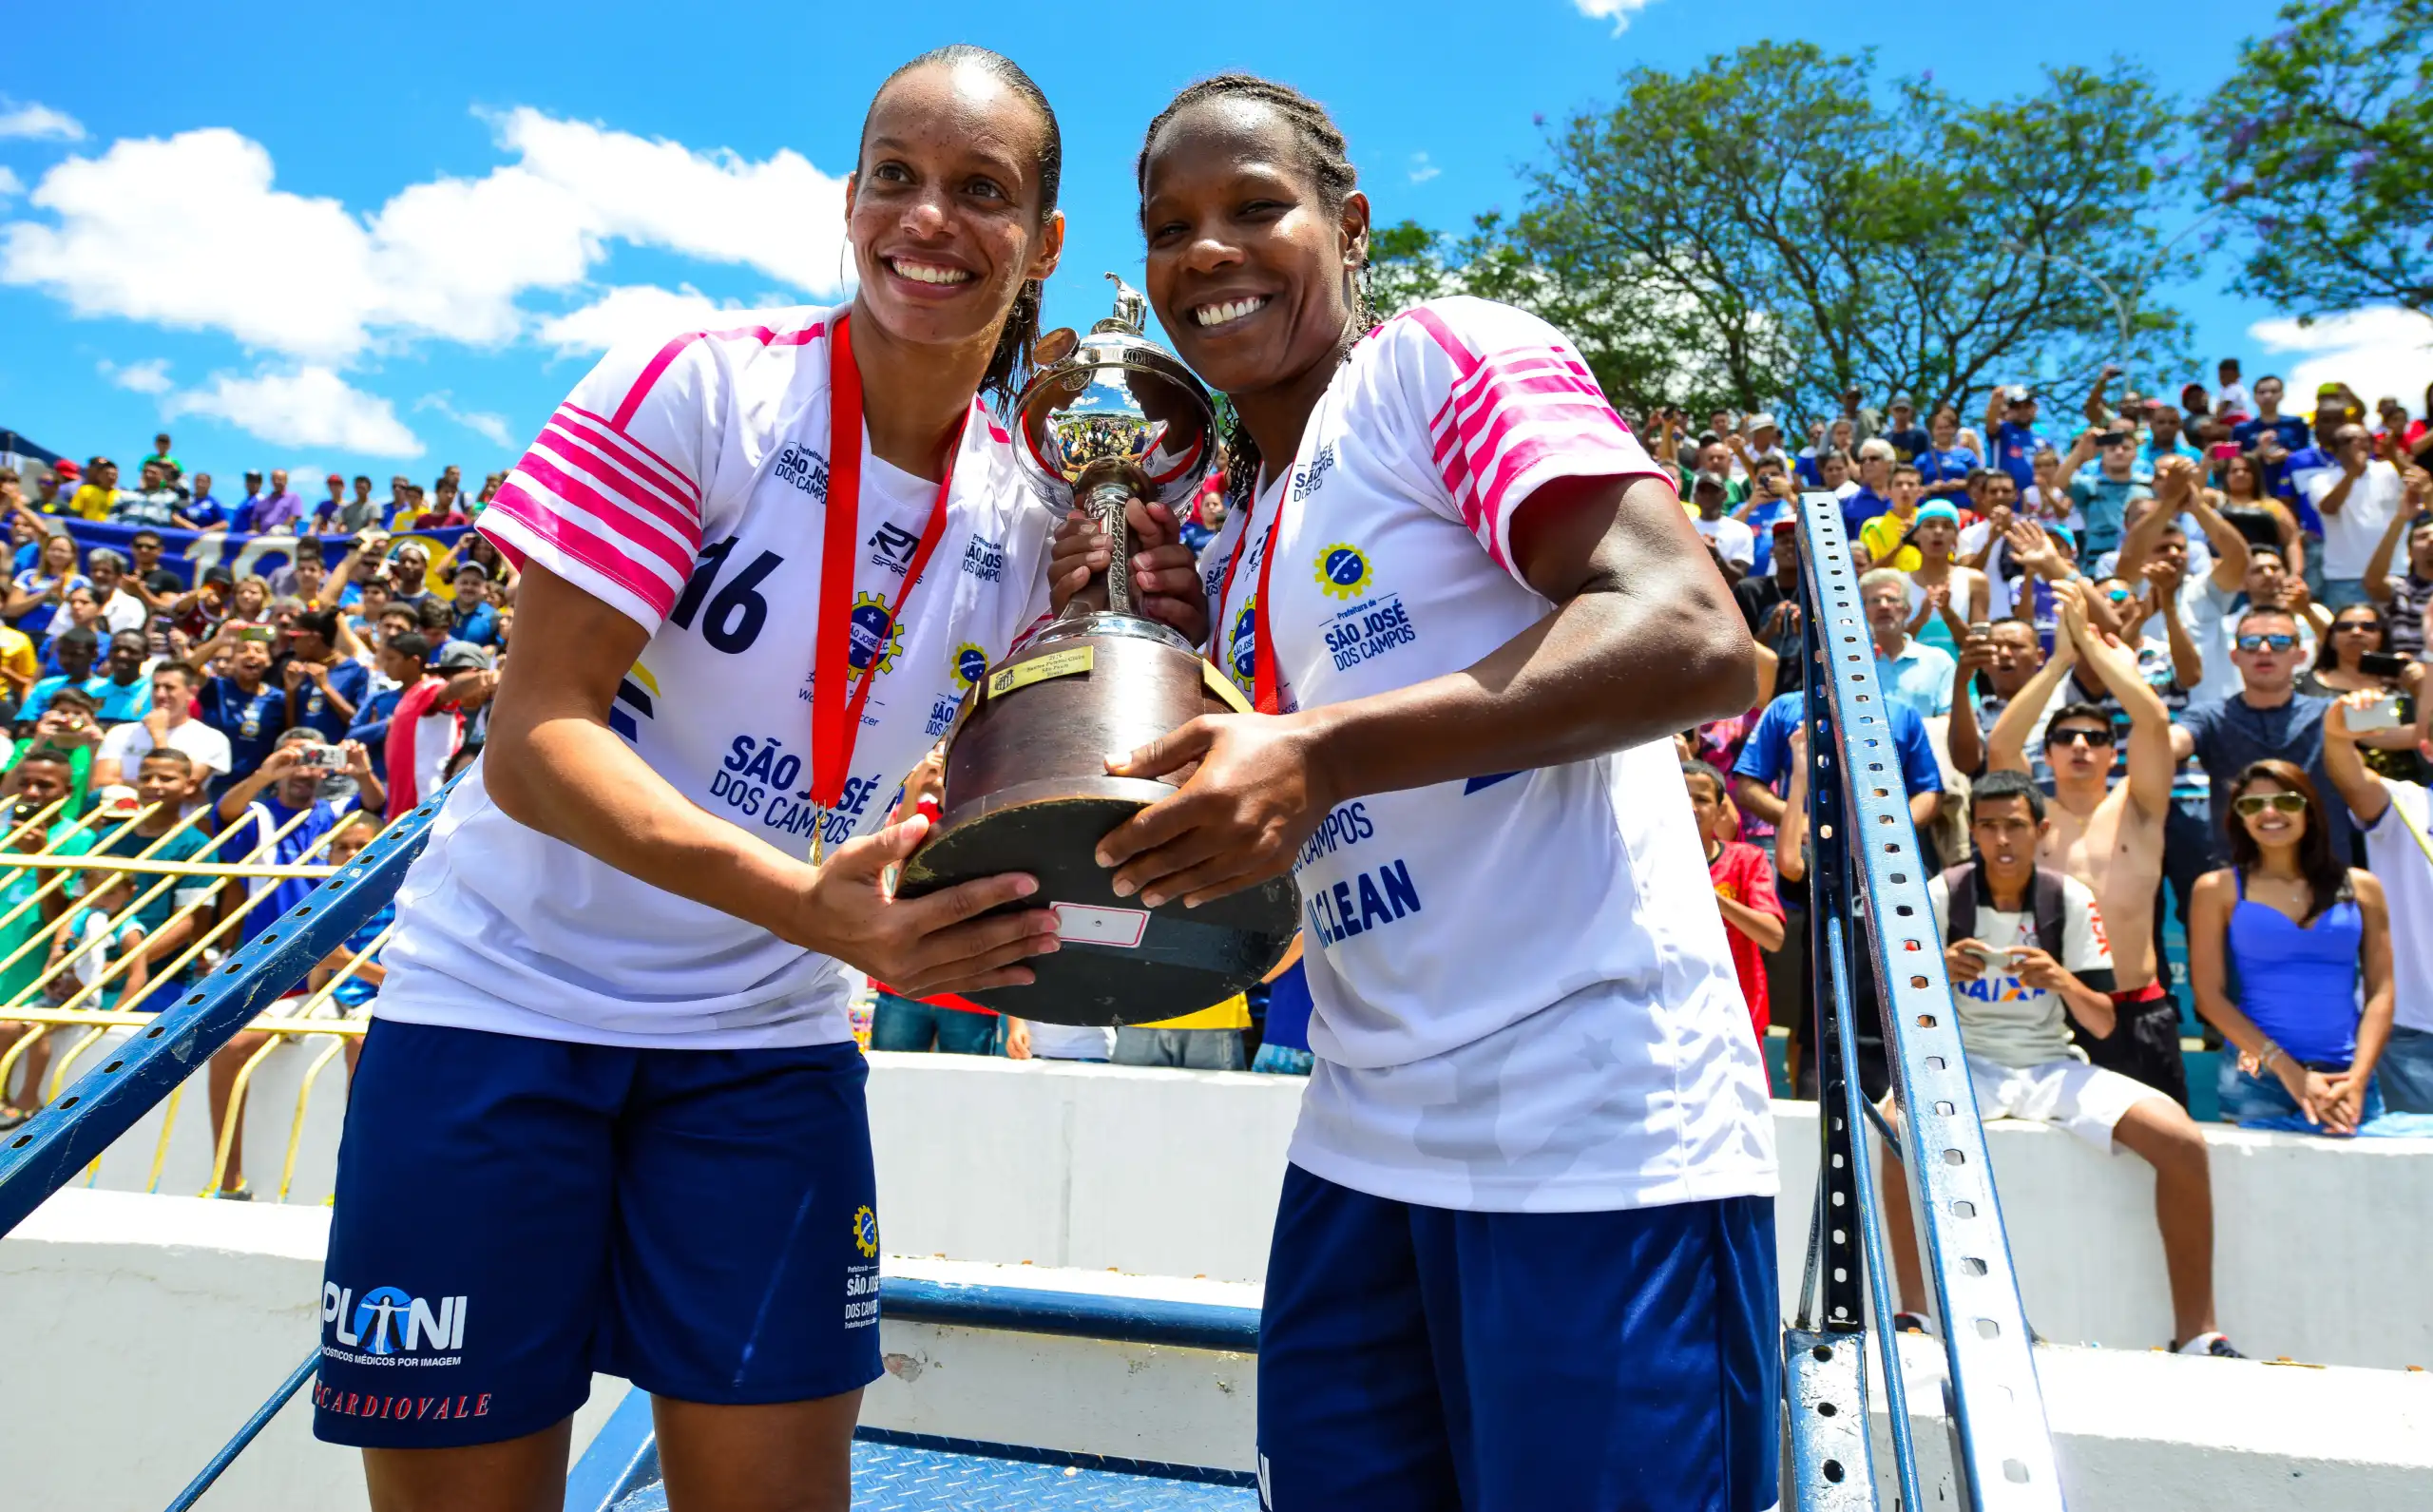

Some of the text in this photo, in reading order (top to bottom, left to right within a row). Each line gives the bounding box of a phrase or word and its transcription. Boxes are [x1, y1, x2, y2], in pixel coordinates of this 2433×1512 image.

[780, 449, 830, 490] SÃO JOS
[774, 463, 828, 504] DOS CAMPO
[871, 554, 924, 585] SPORS
[981, 550, 1003, 569] JOS
[974, 565, 1001, 584] CAMPO
[669, 535, 785, 655] 16
[1336, 598, 1377, 621] Prefeitura de
[850, 624, 860, 639] ÃO
[1324, 598, 1409, 653] SÃO JOSÉ
[1332, 623, 1416, 672] DOS CAMPOS
[858, 714, 880, 727] ccer
[930, 700, 955, 723] SÃO
[925, 719, 943, 737] DOS
[723, 735, 802, 791] SÃO
[709, 769, 766, 817] DOS
[846, 1273, 867, 1296] SÃO
[845, 1303, 861, 1320] DOS
[354, 1354, 395, 1367] MÉDICOS
[396, 1357, 419, 1367] POR
[419, 1356, 462, 1367] IMAGEM
